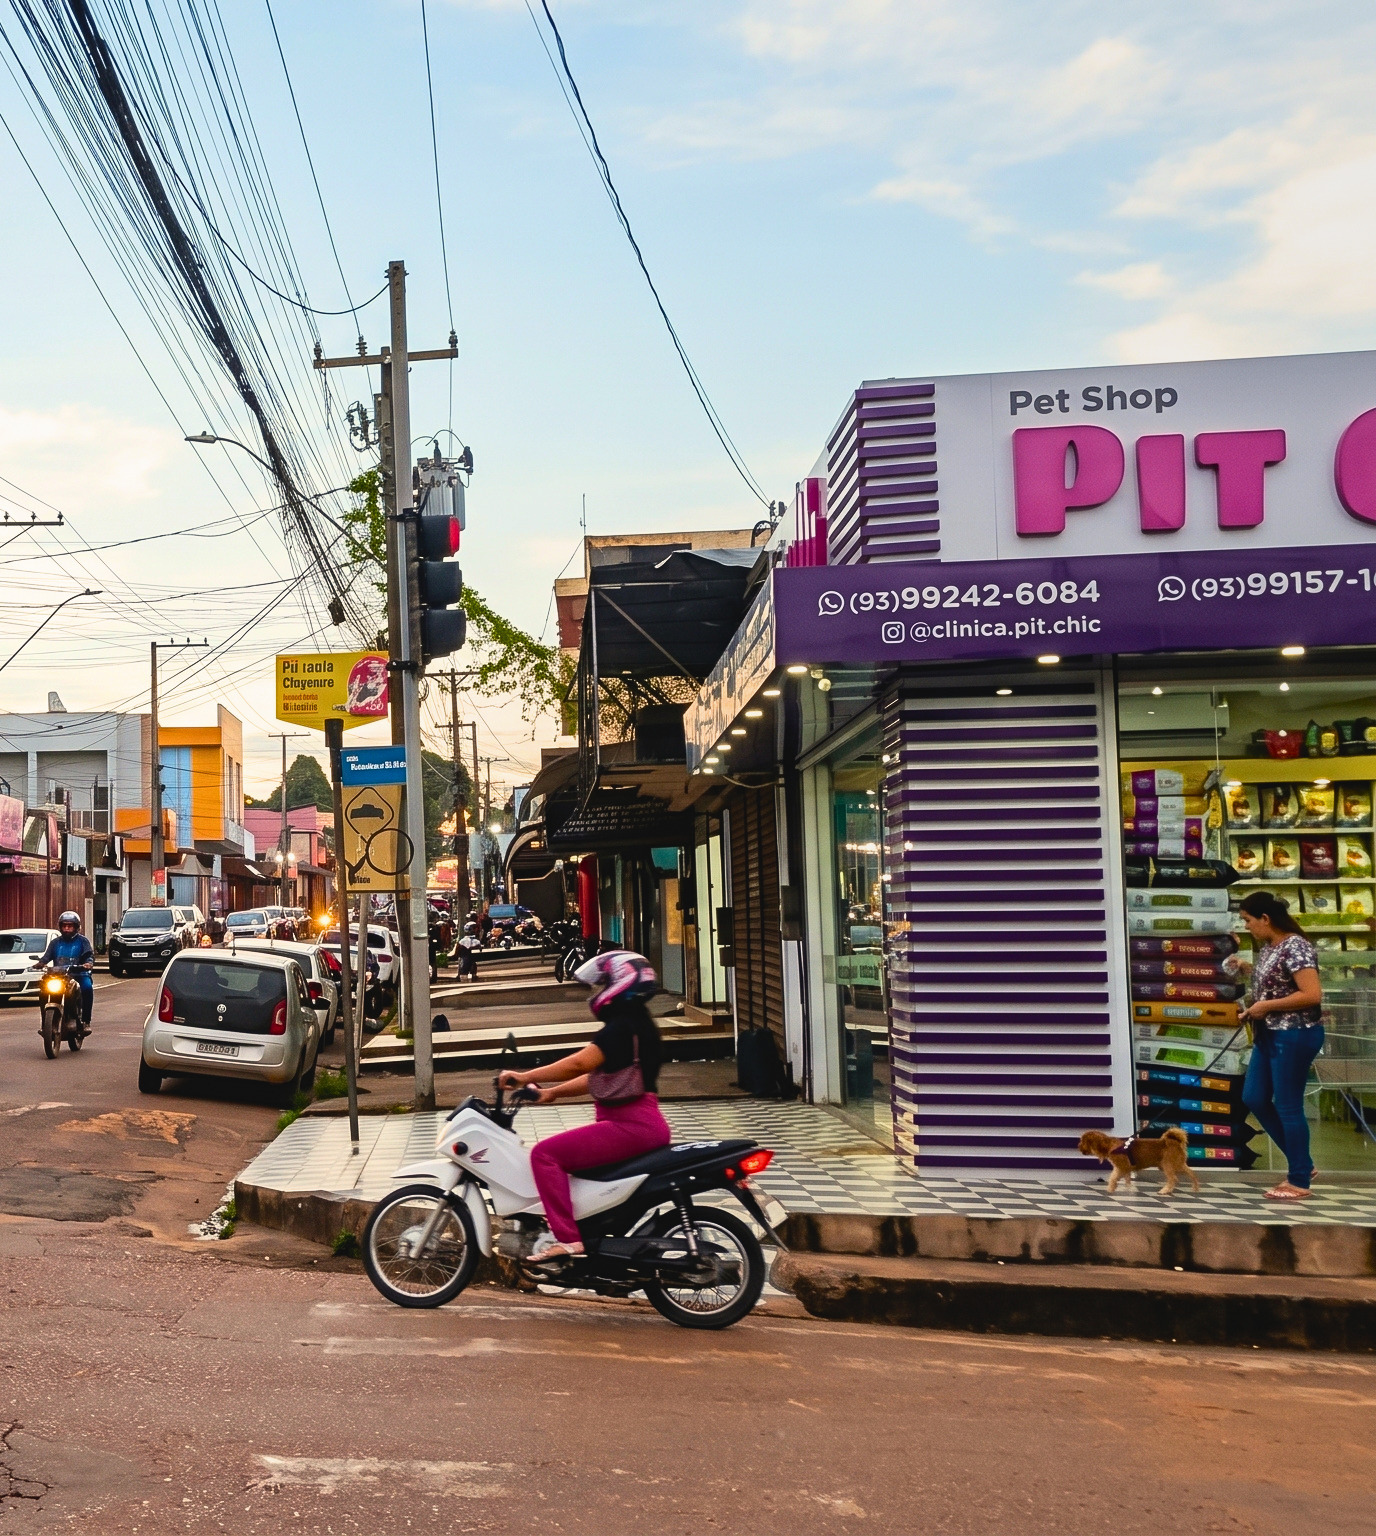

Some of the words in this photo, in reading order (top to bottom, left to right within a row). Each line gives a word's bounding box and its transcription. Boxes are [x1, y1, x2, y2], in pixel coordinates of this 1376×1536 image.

[1009, 388, 1070, 416] Pet
[1082, 384, 1179, 414] Shop
[1011, 424, 1288, 538] PIT
[849, 579, 1101, 613] (93)99242-6084
[1191, 567, 1376, 600] (93)99157-1
[909, 615, 1102, 644] @clinica.pit.chic
